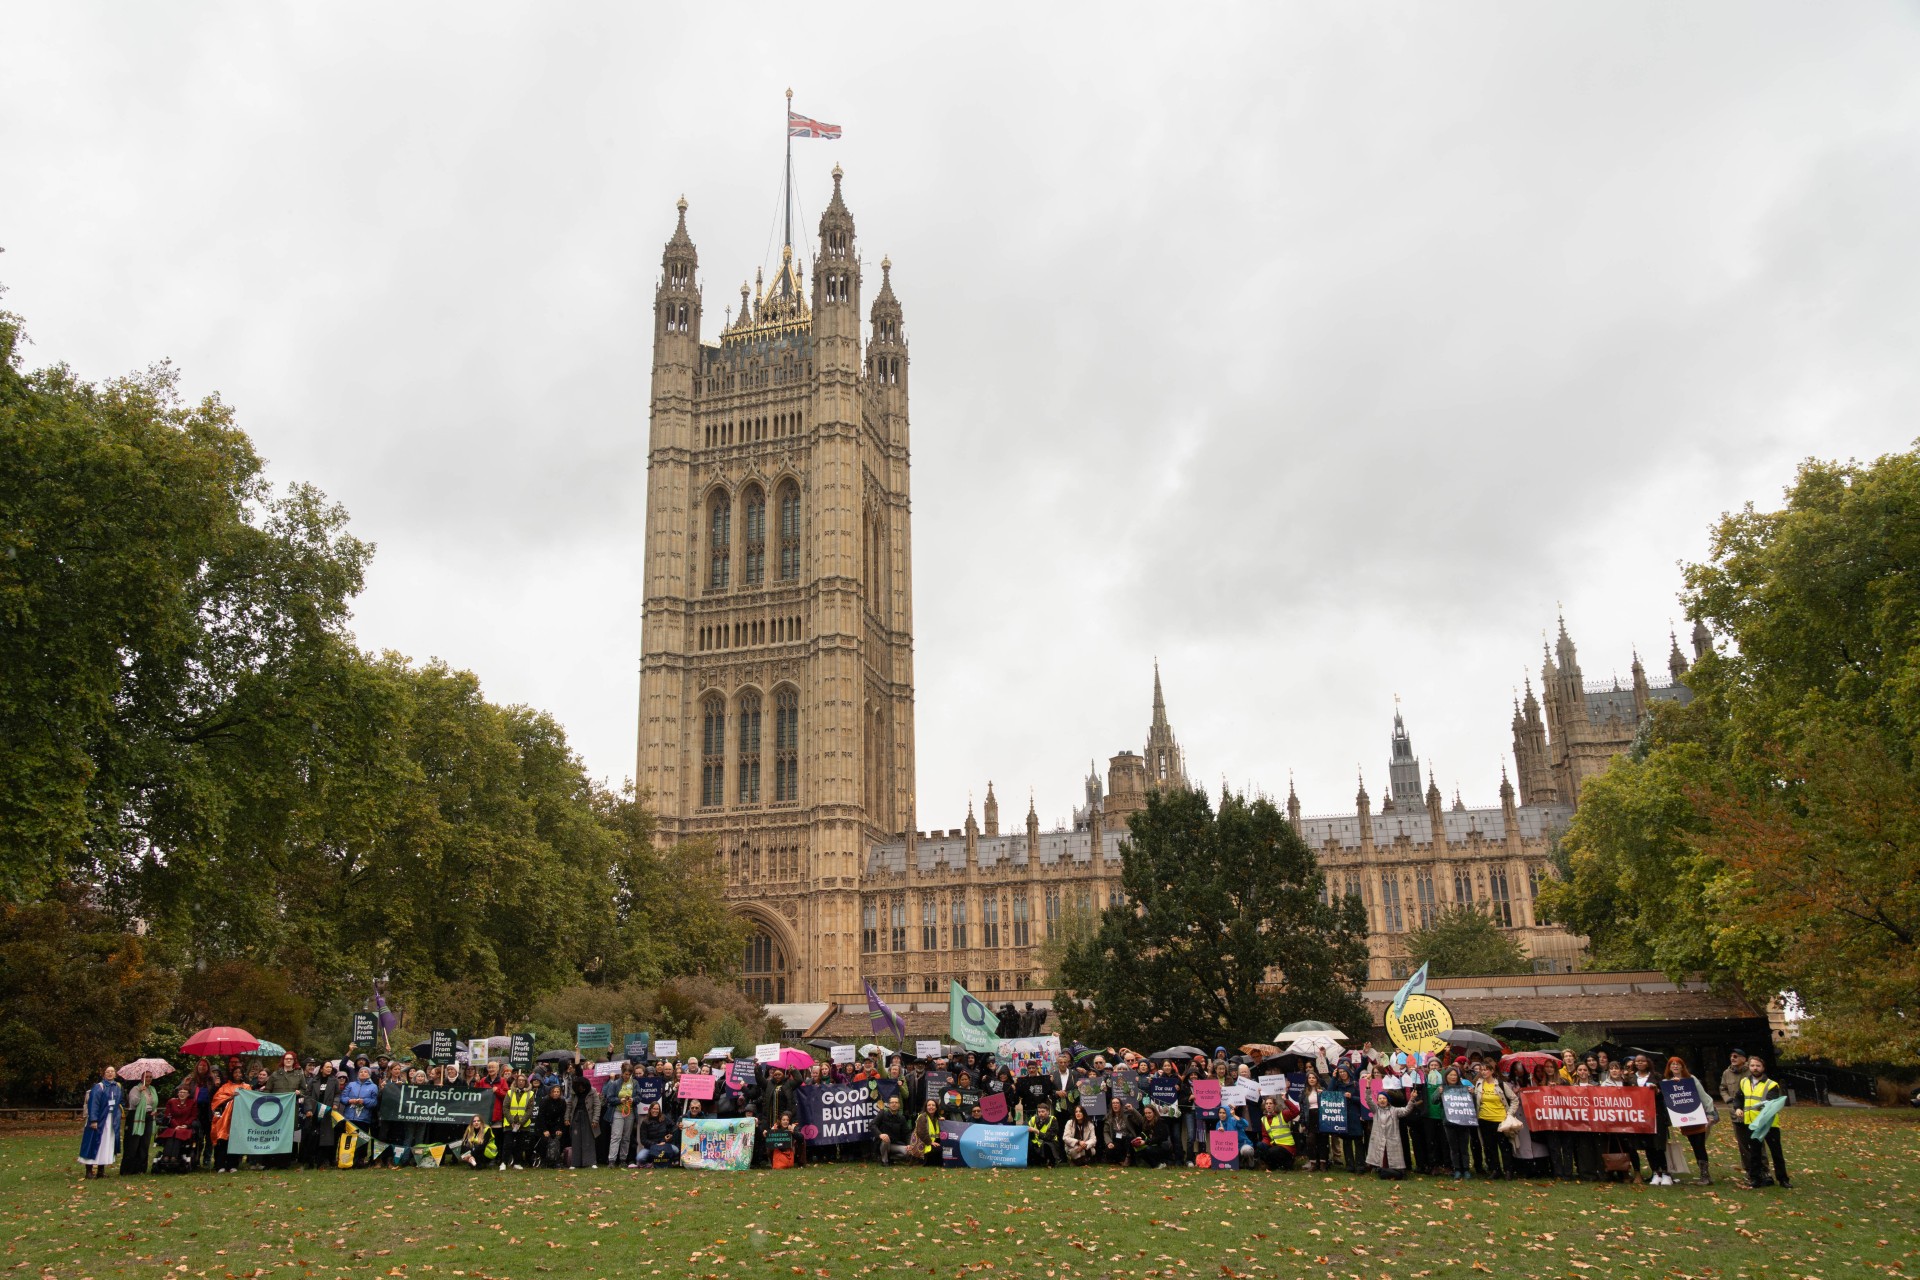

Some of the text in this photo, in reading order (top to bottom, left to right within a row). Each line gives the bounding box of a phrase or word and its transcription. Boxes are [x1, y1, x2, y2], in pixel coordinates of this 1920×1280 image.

[1398, 1010, 1436, 1024] LABOUR
[1400, 1018, 1439, 1034] BEHIND
[408, 1085, 482, 1102] Transform
[822, 1087, 869, 1105] GOOD
[1669, 1091, 1692, 1099] gender
[406, 1101, 446, 1115] Trade
[1320, 1100, 1345, 1108] Planet
[1542, 1095, 1633, 1108] FEMINISTS DEMAND
[1673, 1098, 1694, 1106] justice
[822, 1102, 888, 1121] BUSINES
[1321, 1114, 1345, 1122] Profit
[1447, 1107, 1474, 1115] Profit
[1535, 1107, 1646, 1122] CLIMATE JUSTICE
[823, 1119, 873, 1138] MATTE
[979, 1153, 1016, 1162] Environment
